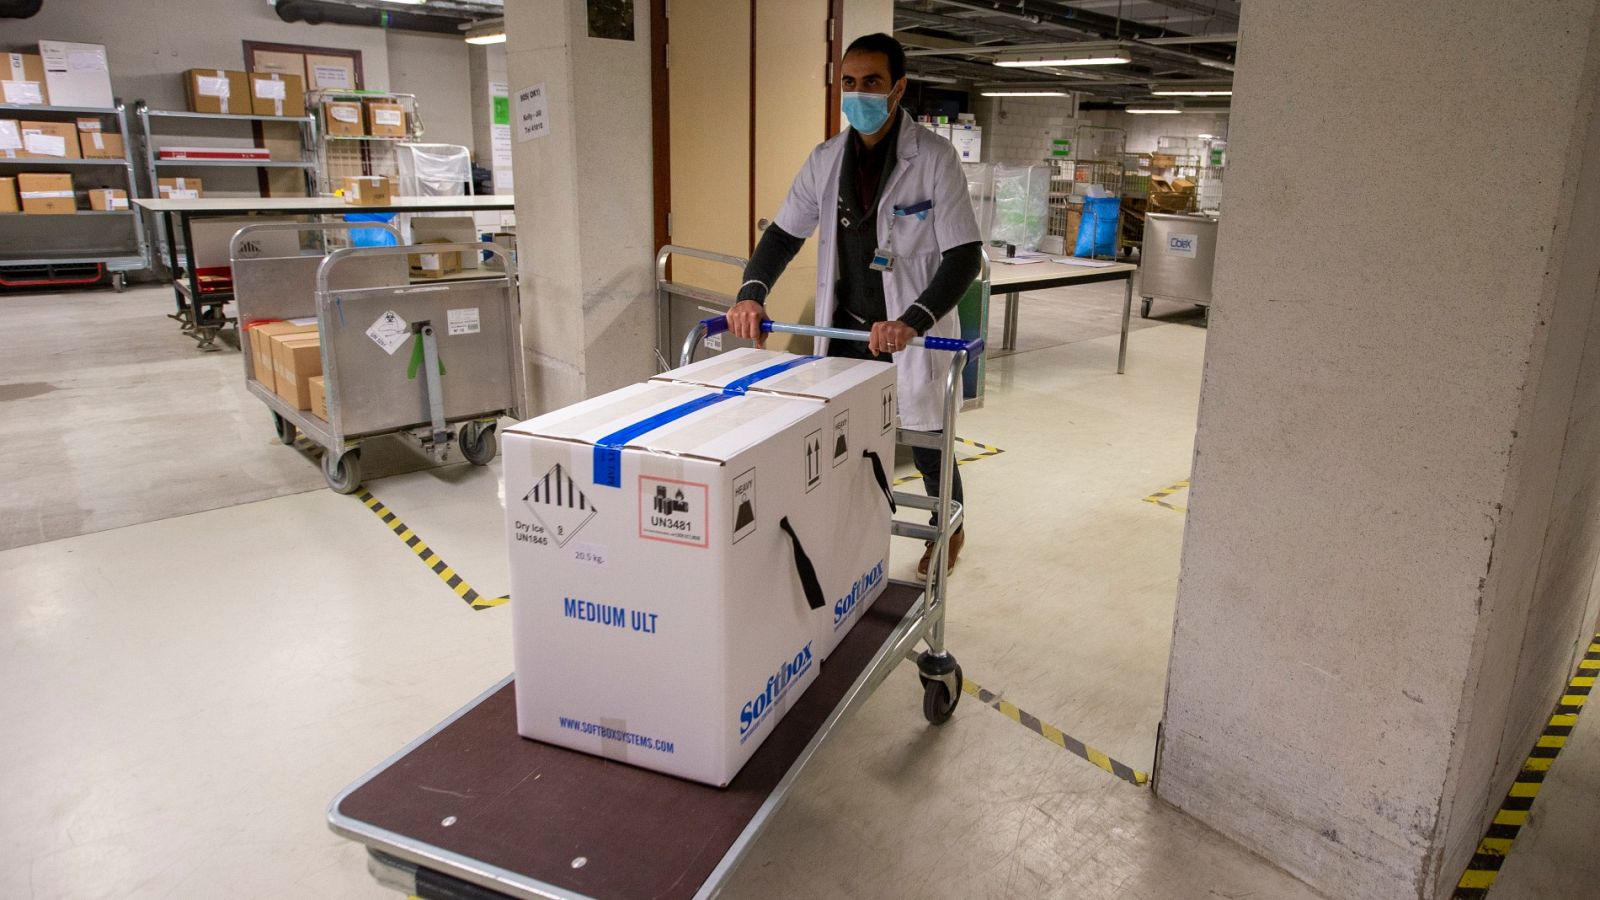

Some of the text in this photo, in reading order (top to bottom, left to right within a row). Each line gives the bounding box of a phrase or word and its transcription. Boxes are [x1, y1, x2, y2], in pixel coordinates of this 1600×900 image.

[835, 419, 848, 430] HEAVY
[735, 479, 753, 495] HEAVY
[515, 520, 545, 534] Dry Ice
[651, 516, 692, 531] UN3481
[515, 532, 548, 546] UN1845
[834, 559, 883, 625] Softbox
[564, 597, 658, 634] MEDIUM ULT
[740, 640, 813, 735] Softbox
[559, 716, 675, 754] WWW.SOFTBOXSYSTEMS.COM
